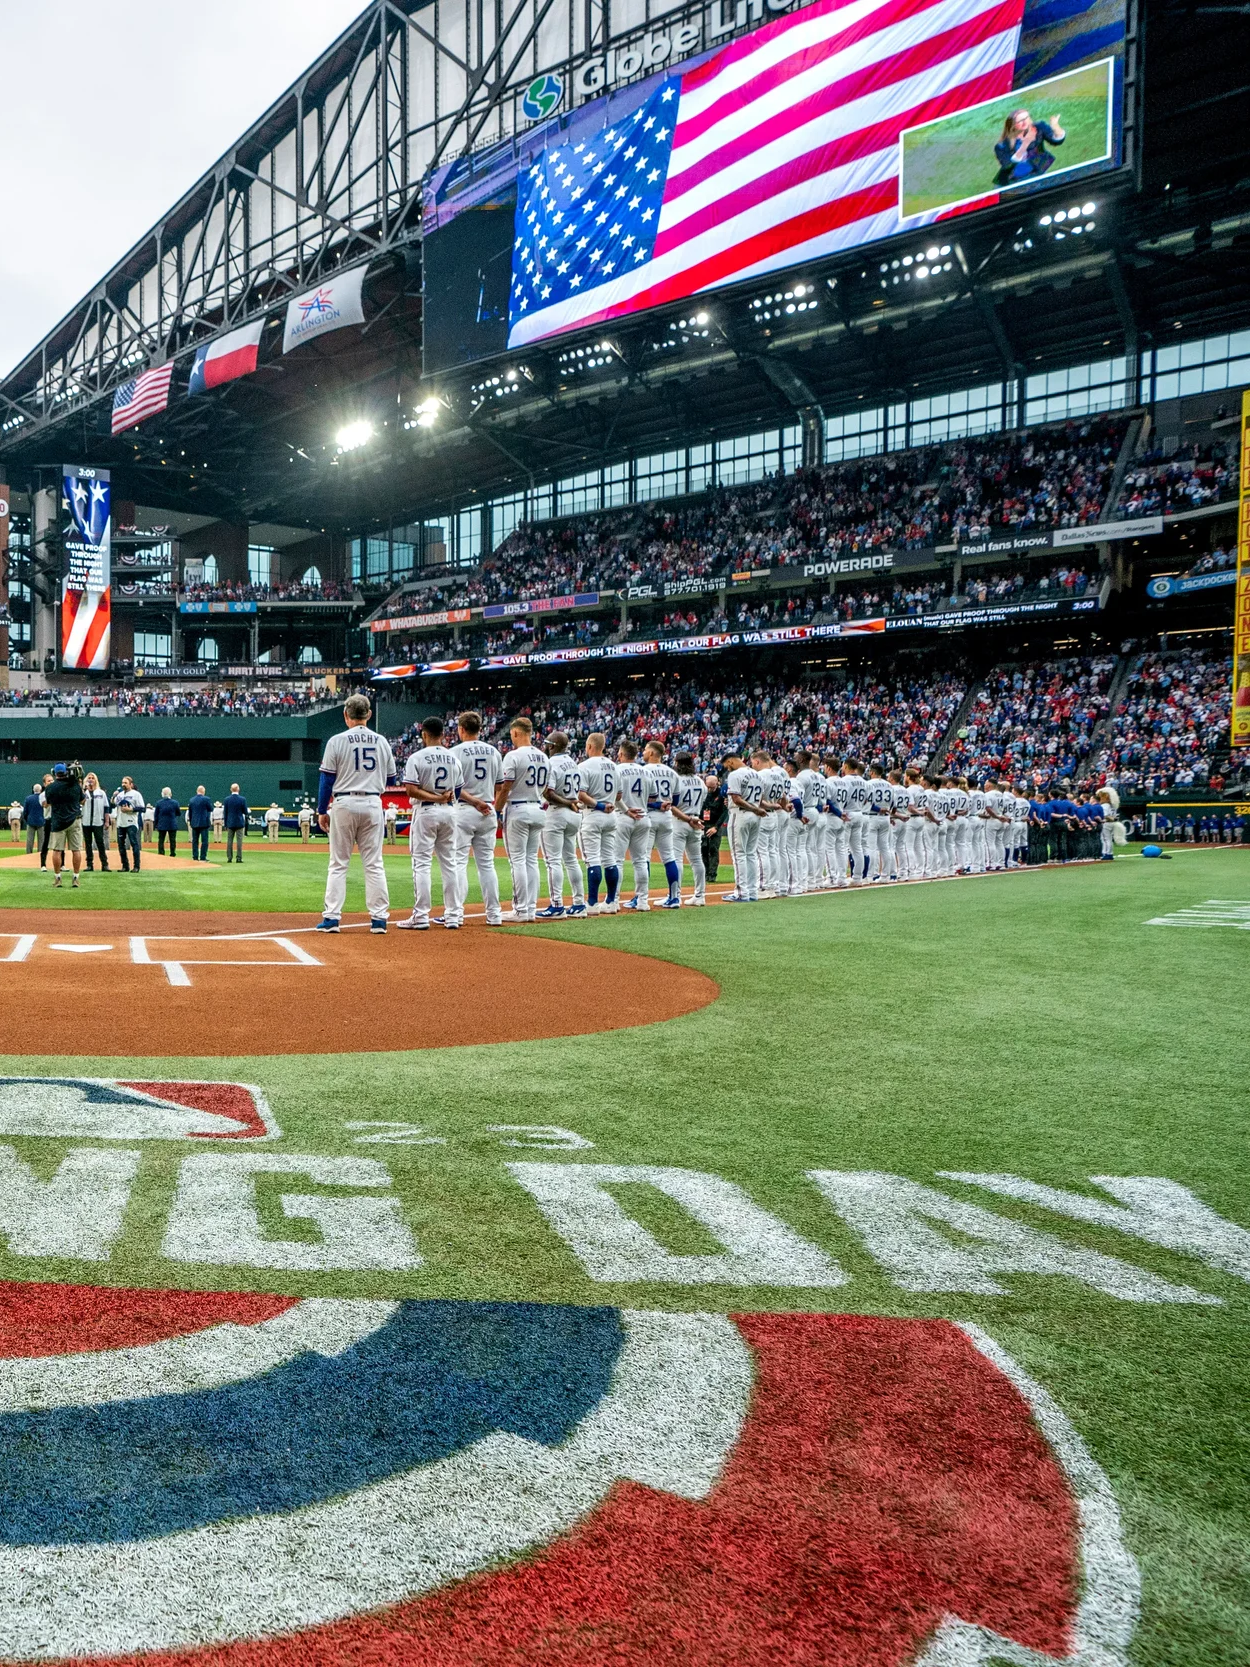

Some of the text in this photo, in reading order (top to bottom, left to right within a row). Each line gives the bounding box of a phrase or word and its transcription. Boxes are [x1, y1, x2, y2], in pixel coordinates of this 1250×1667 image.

[575, 24, 701, 95] Globe
[290, 308, 341, 339] ARLINGTON
[78, 468, 96, 478] 3:00
[65, 542, 107, 552] GAVE PROOF
[961, 536, 1048, 555] Real fans know.
[71, 551, 102, 560] THROUGH
[90, 568, 102, 576] OUR
[804, 554, 894, 577] POWERADE
[67, 582, 84, 590] STILL
[88, 576, 103, 584] WAS
[664, 576, 727, 589] ShipPGL.com
[627, 585, 658, 598] PGL
[503, 597, 575, 615] 105.3 THE FAN
[945, 610, 963, 619] GAVE
[963, 609, 986, 618] PROOF
[987, 606, 1020, 616] THROUGH
[1021, 604, 1034, 613] THE
[1036, 602, 1058, 612] NIGHT
[1072, 600, 1094, 611] 3:00
[390, 612, 449, 629] WHATABURGER
[886, 617, 923, 629] ELOUAN
[924, 620, 940, 628] THAT
[956, 617, 972, 625] FLAG
[973, 616, 988, 624] WAS
[989, 614, 1005, 622] STILL
[503, 625, 841, 665] GAVE PROOF THROUGH THE NIGHT THAT OUR FLAG WAS STILL THERE
[144, 667, 206, 676] PRIORITY GOLD
[228, 666, 254, 675] HART
[303, 667, 350, 675] PLUCKERS
[348, 733, 380, 745] BOCHY
[353, 747, 377, 772] 15
[425, 754, 456, 765] SEMIEN
[527, 753, 546, 764] LOWE
[474, 758, 487, 780] 5
[525, 765, 548, 787] 30
[434, 766, 448, 790] 2
[562, 773, 581, 794] 53
[604, 773, 613, 793] 6
[631, 778, 643, 793] 4
[655, 779, 671, 798] 13
[769, 783, 783, 799] 66
[682, 788, 702, 807] 47
[746, 785, 762, 802] 72
[837, 789, 847, 803] 50
[851, 788, 866, 802] 46
[875, 789, 892, 803] 33
[897, 797, 910, 809] 23
[504, 1168, 1250, 1307] DAY
